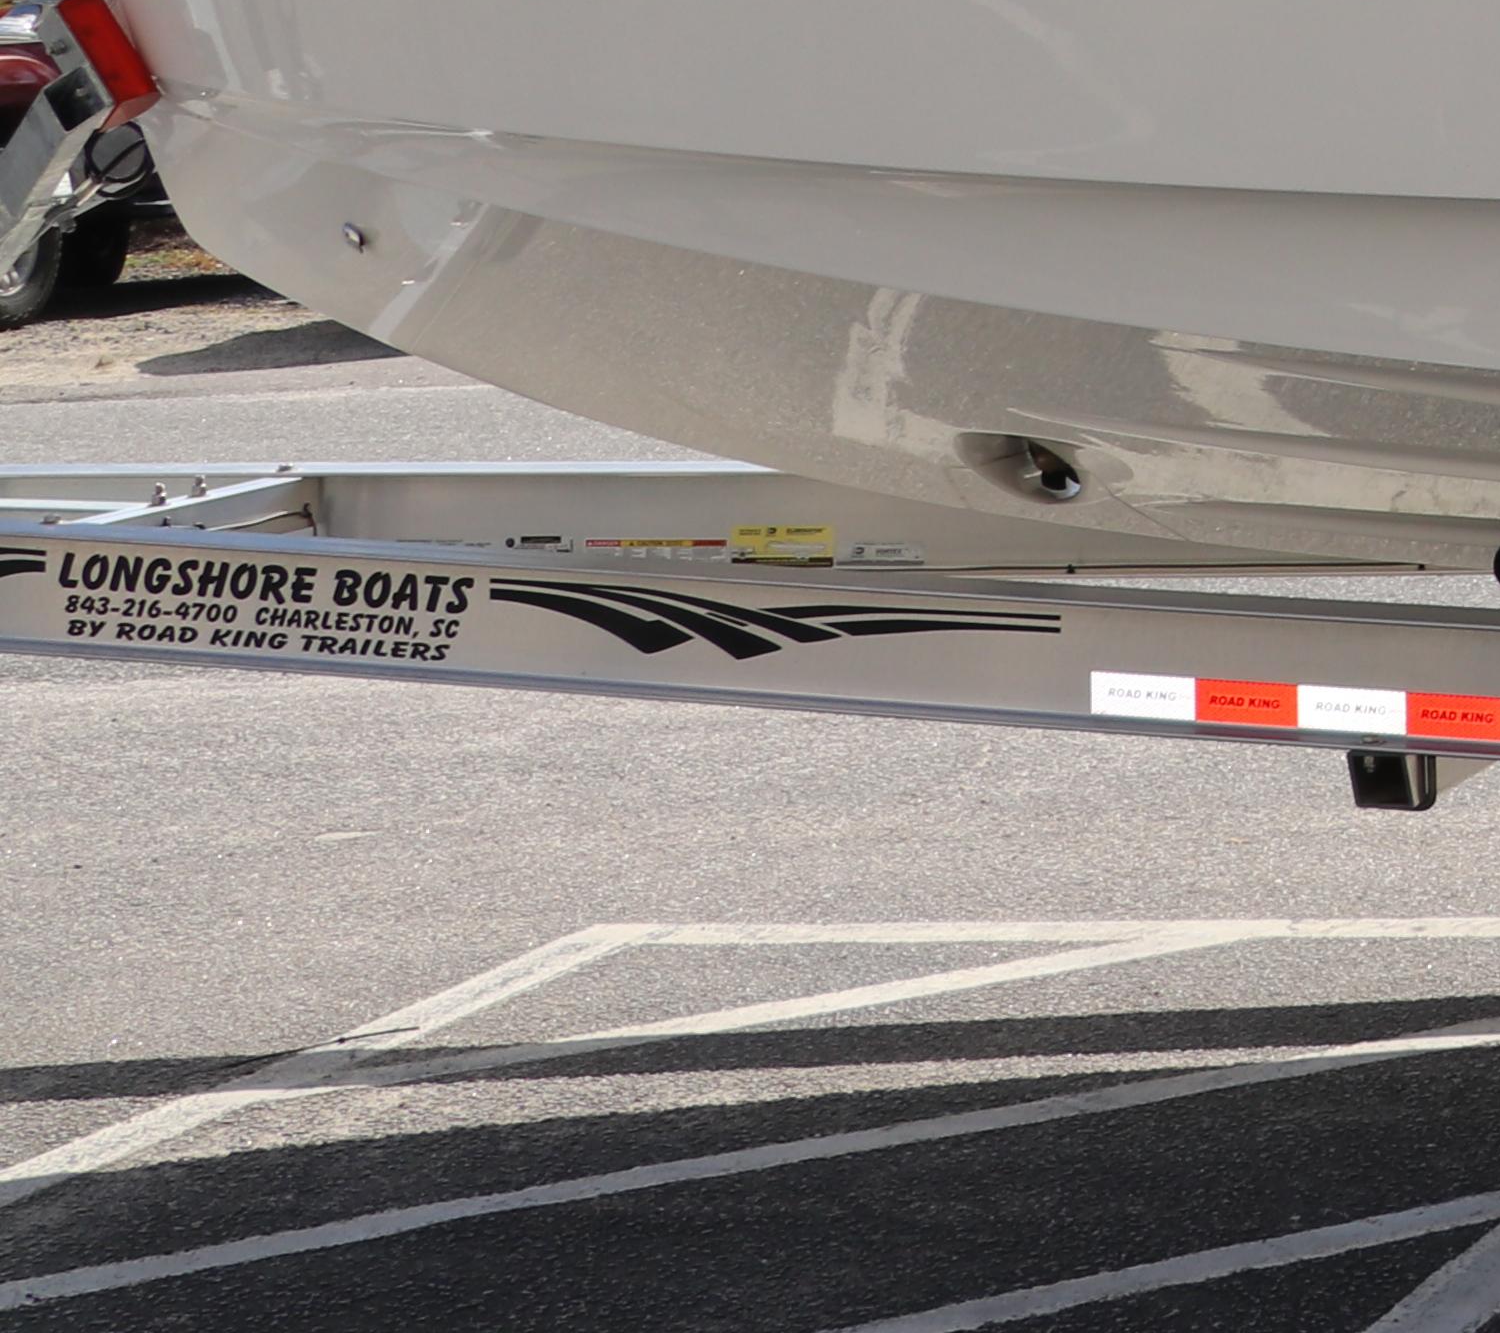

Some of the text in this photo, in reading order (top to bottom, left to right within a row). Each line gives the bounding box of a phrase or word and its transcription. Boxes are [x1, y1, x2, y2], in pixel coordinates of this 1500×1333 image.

[58, 552, 475, 614] LONGSHORE BOATS
[65, 595, 460, 639] 843-216-4700 CHARLESTON, SC
[67, 619, 451, 662] BY ROAD KING TRAILERS
[1108, 687, 1177, 701] ROAD KING
[1210, 695, 1280, 710] ROAD KING
[1315, 701, 1387, 716] ROAD KING
[1421, 709, 1494, 724] ROAD KING
